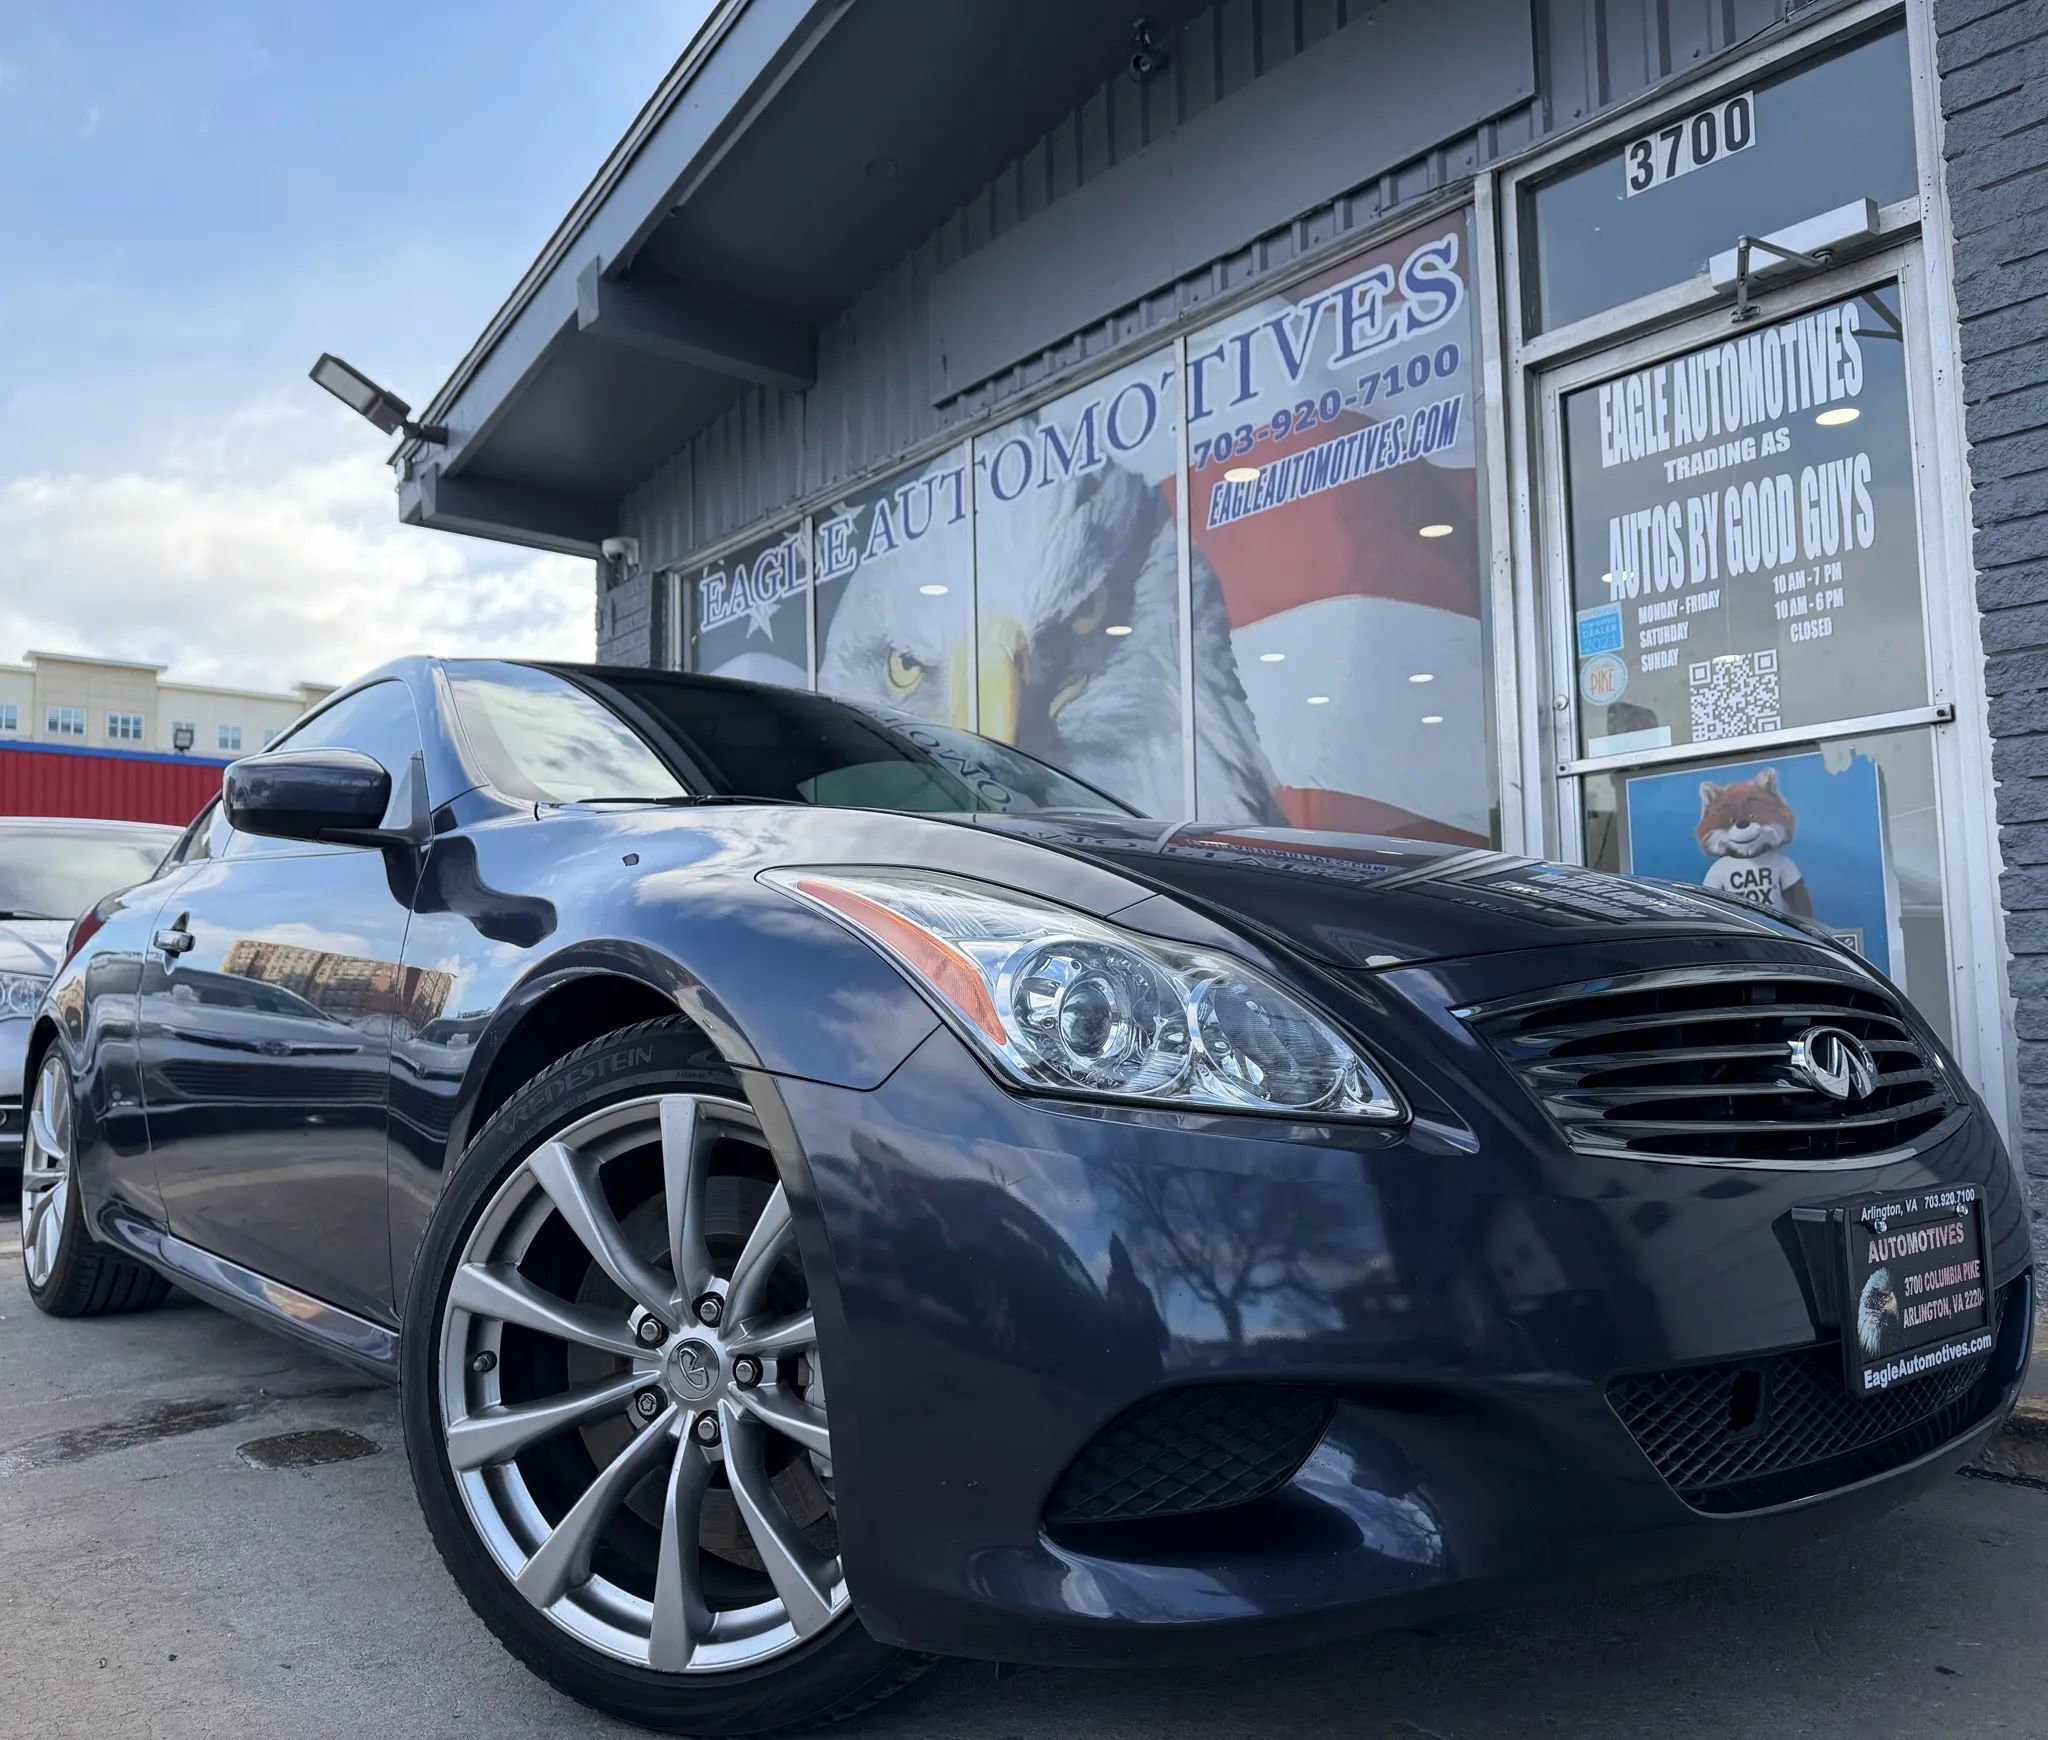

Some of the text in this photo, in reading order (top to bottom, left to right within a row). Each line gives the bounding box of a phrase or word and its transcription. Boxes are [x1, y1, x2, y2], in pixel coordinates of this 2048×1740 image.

[1629, 97, 1751, 191] 3700
[1599, 302, 1864, 469] EAGLE AUTOMOTIVES
[1193, 343, 1460, 471] 703-920-7100
[700, 232, 1464, 633] EAGLE AUTOMOTIVES
[1206, 393, 1465, 531] EAGLEAUTOMOTIVES.COM
[1663, 427, 1791, 483] TRADING AS
[1608, 452, 1876, 601] AUTOS BY GOOD GUYS
[1772, 574, 1786, 594] 10
[1788, 569, 1806, 591] AM
[1813, 566, 1820, 586] 7
[1824, 561, 1843, 583] PM
[1638, 599, 1678, 625] MONDAY
[1685, 589, 1721, 615] FRIDAY
[1774, 600, 1788, 620] 10
[1790, 595, 1808, 617] AM
[1815, 591, 1824, 611] 6
[1825, 588, 1844, 608] PM
[1640, 621, 1689, 649] SATURDAY
[1790, 617, 1833, 643] CLOSED
[1641, 648, 1679, 673] SUNDAY
[1729, 867, 1773, 889] CAR
[1861, 1188, 1975, 1221] Arlington, VA 703.920.7100
[1867, 1222, 1965, 1264] AUTOMOTIVES
[1904, 1259, 1981, 1296] 3700 COLUMBIA PIKE
[1903, 1297, 1952, 1328] ARLINGTON,
[1952, 1293, 1964, 1313] VA
[1863, 1334, 1992, 1389] EagleAutomotives.com
